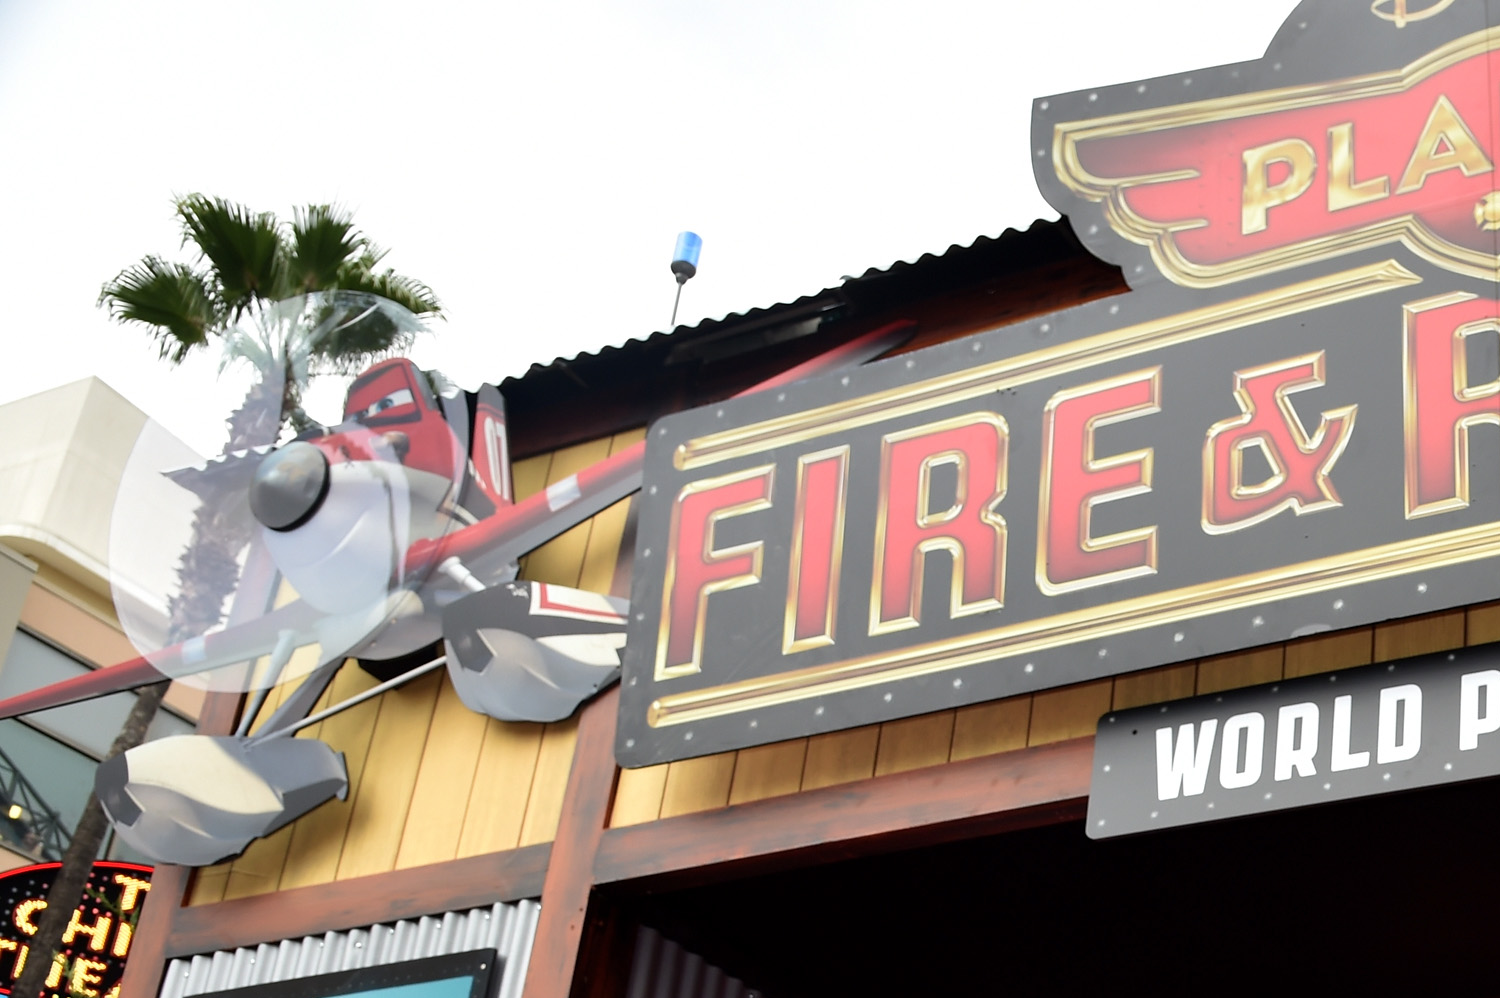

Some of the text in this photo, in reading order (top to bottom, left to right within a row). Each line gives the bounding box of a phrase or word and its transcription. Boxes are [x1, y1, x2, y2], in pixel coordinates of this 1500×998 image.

[653, 364, 1164, 681] FIRE
[1200, 348, 1358, 536] &
[1154, 683, 1423, 802] WORLD
